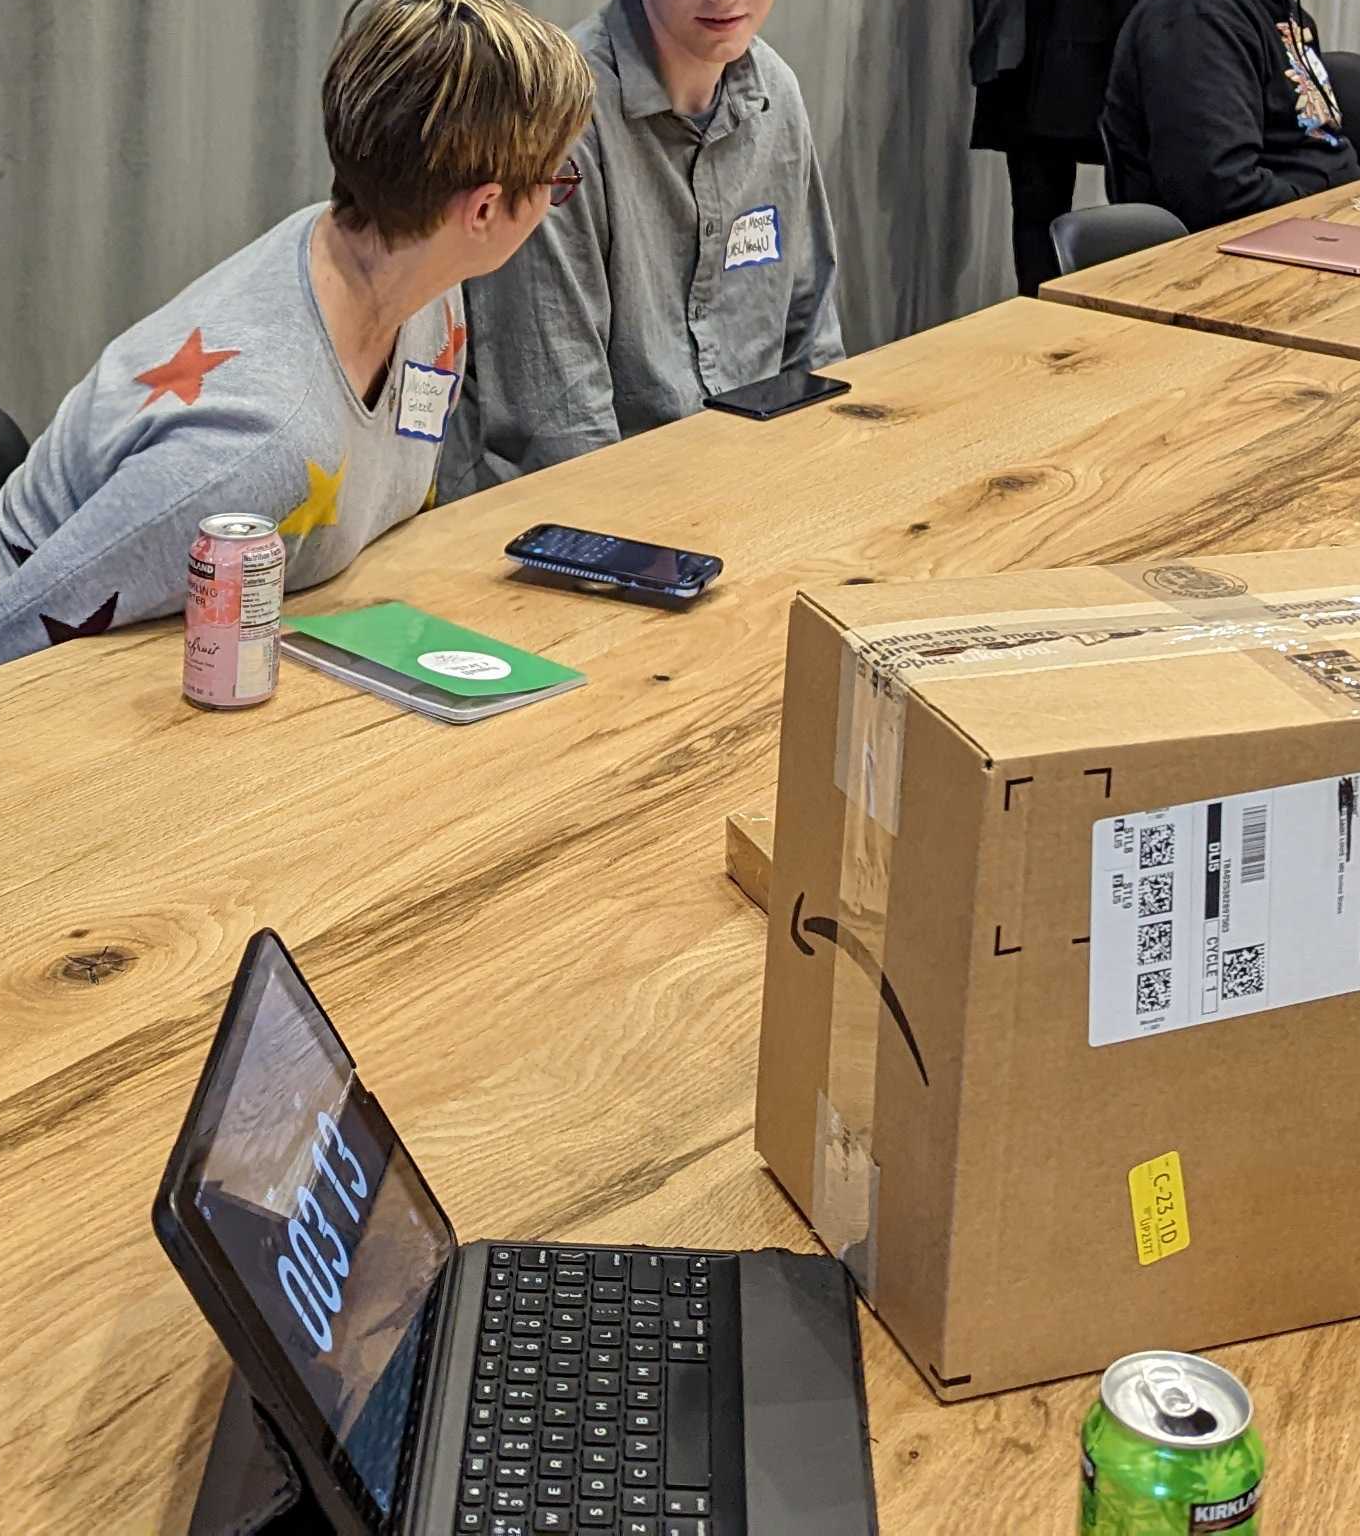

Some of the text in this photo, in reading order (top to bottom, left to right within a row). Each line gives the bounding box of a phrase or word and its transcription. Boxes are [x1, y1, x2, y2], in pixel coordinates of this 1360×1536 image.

[935, 624, 998, 638] small
[970, 634, 997, 645] to
[1000, 629, 1060, 642] more
[1207, 842, 1221, 873] DLI5
[1206, 936, 1219, 978] CYCLE
[1152, 1172, 1178, 1244] C-23.1D
[1194, 1482, 1264, 1523] KIRKLA
